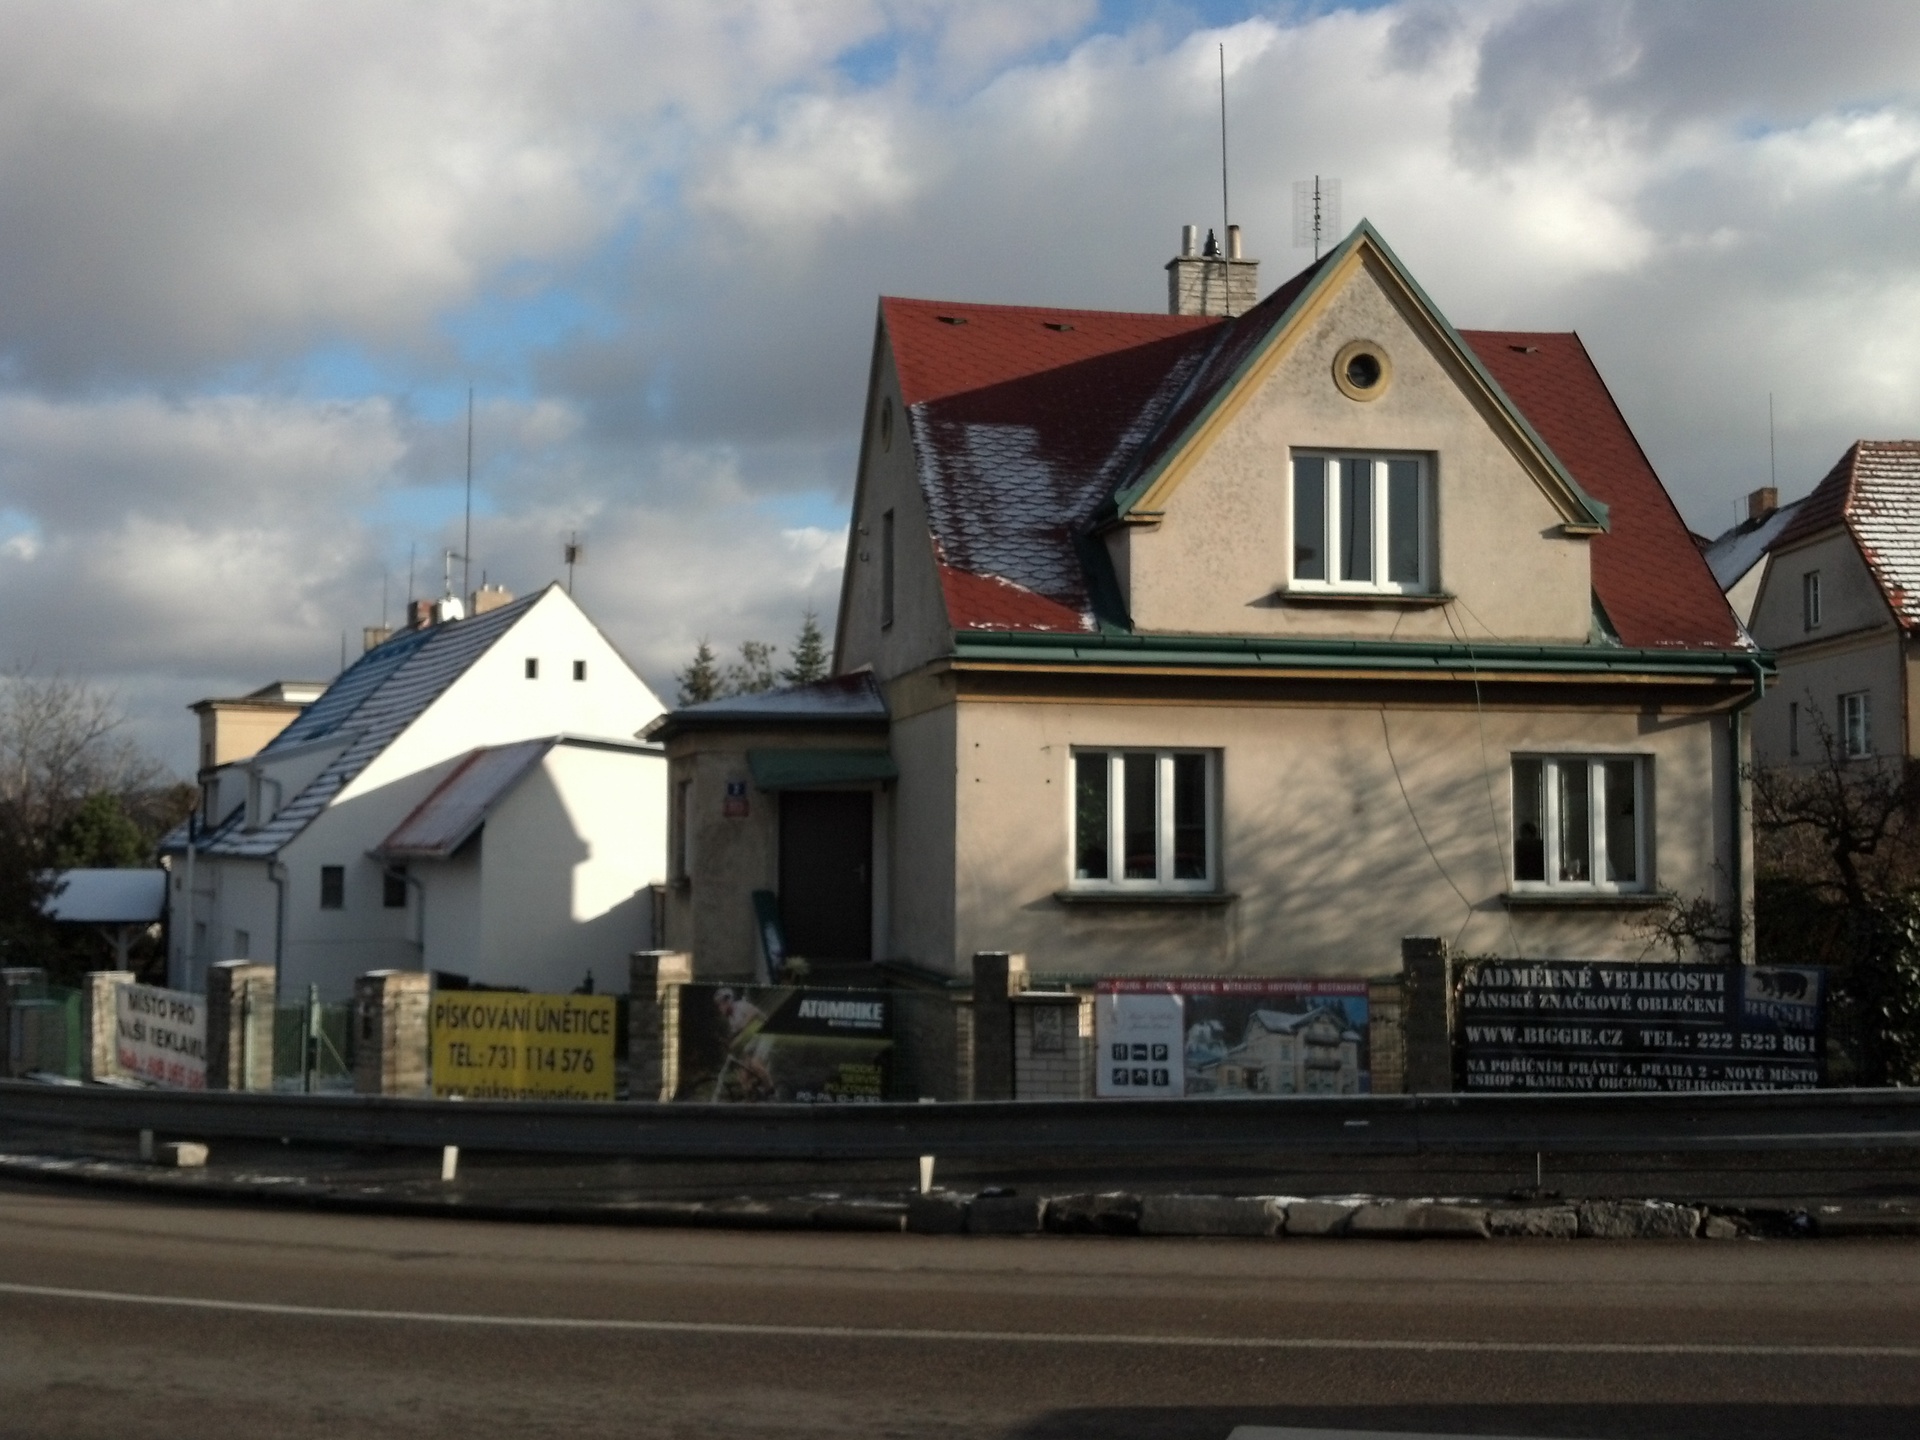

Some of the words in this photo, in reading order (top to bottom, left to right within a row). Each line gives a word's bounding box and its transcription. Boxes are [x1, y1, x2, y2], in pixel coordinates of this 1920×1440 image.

[1464, 964, 1593, 989] NADMĚRNÉ
[1599, 970, 1725, 992] VELIKOSTI
[169, 1000, 196, 1025] PRO
[797, 999, 884, 1020] ATOMBIKE
[1464, 990, 1535, 1009] PÁNSKÉ
[1539, 992, 1632, 1011] ZNAČKOVÉ
[1636, 994, 1724, 1013] OBLEČENÍ
[435, 998, 531, 1031] PÍSKOVÁNÍ
[535, 1000, 610, 1034] ÚNĚTICE
[1464, 1026, 1623, 1046] WWW.BIGGIE.CZ
[1639, 1030, 1690, 1047] TEL.:
[1696, 1031, 1733, 1049] 222
[1740, 1033, 1777, 1051] 523
[1782, 1034, 1816, 1053] 861
[449, 1042, 483, 1067] TEL.:
[487, 1045, 516, 1070] 731
[526, 1046, 556, 1071] 114
[560, 1048, 594, 1073] 576
[1466, 1059, 1486, 1072] NA
[1568, 1060, 1619, 1076] PRÁVU
[1641, 1063, 1693, 1078] PRAHA
[1698, 1066, 1708, 1078] 2
[1724, 1065, 1765, 1080] NOVÉ
[1769, 1067, 1819, 1083] MĚSTO
[1666, 1078, 1745, 1092] VELIKOSTI
